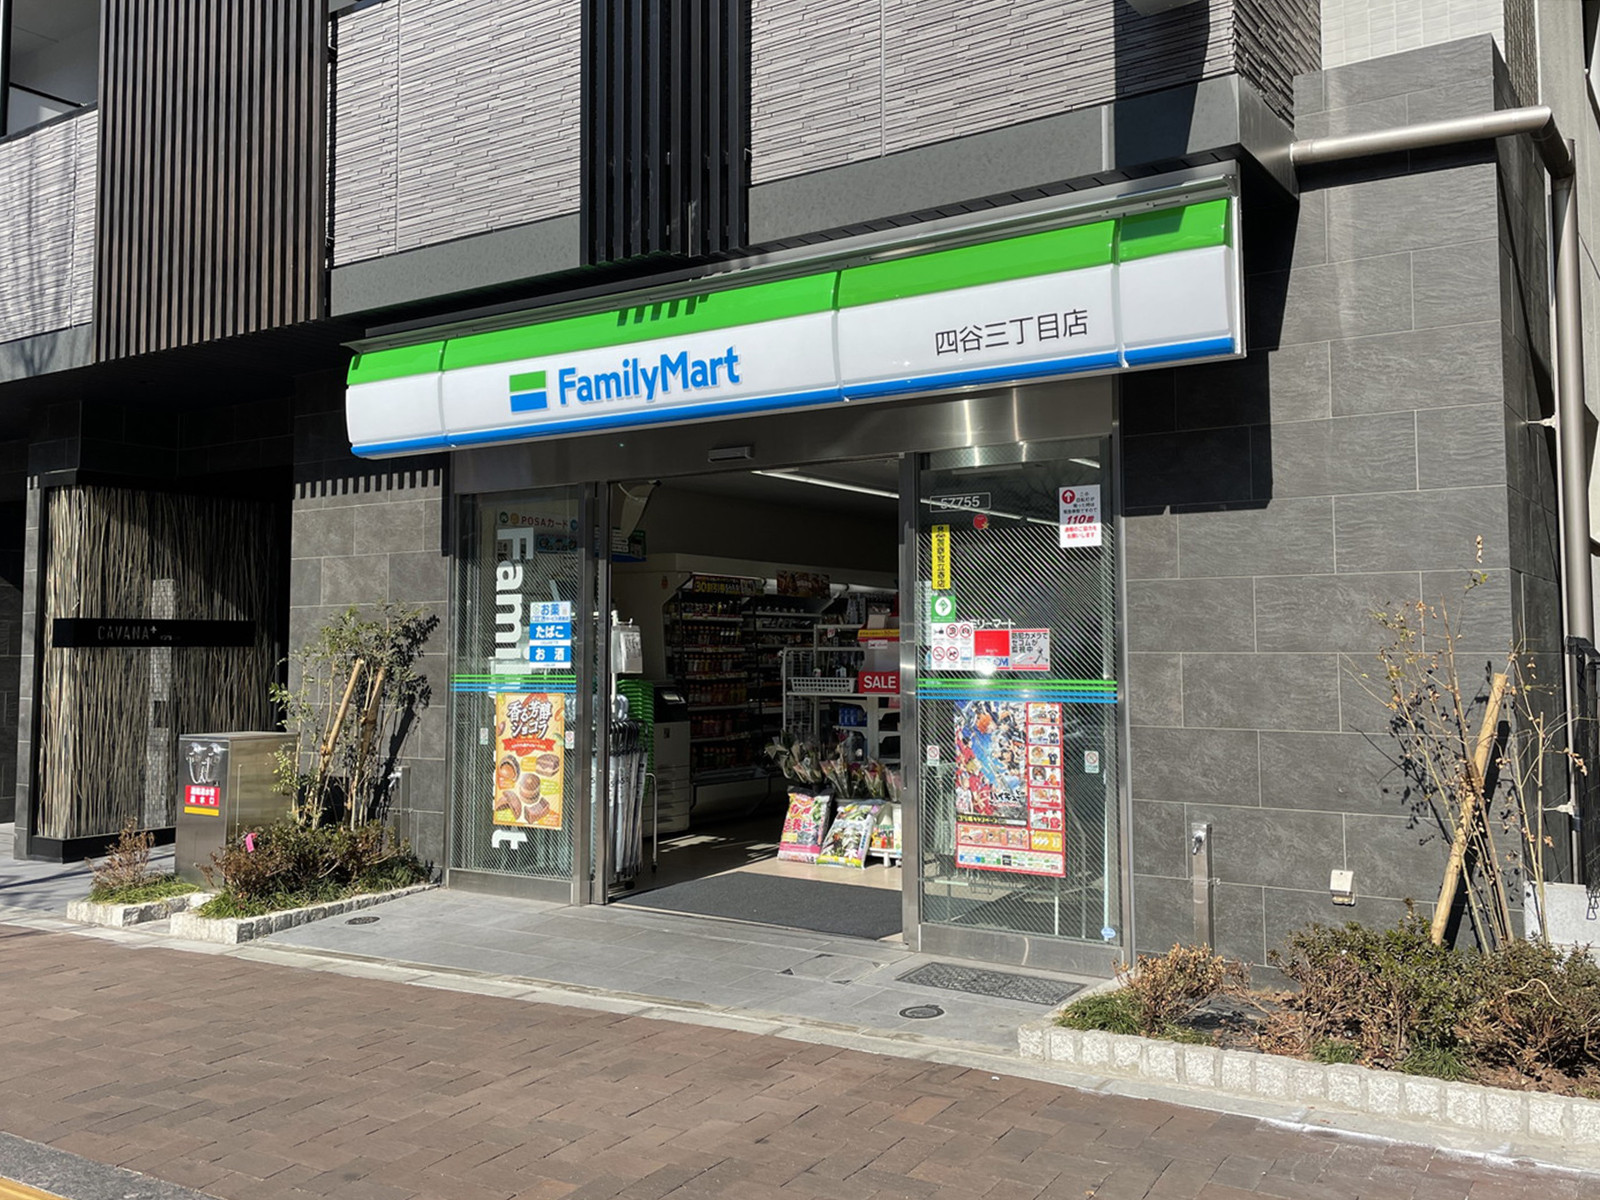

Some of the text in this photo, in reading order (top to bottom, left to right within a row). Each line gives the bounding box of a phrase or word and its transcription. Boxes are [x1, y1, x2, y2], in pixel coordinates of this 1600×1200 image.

[935, 309, 1088, 356] 四谷三丁目店
[558, 345, 741, 406] FamilyMart
[535, 625, 564, 639] たばこ
[863, 675, 897, 689] SALE
